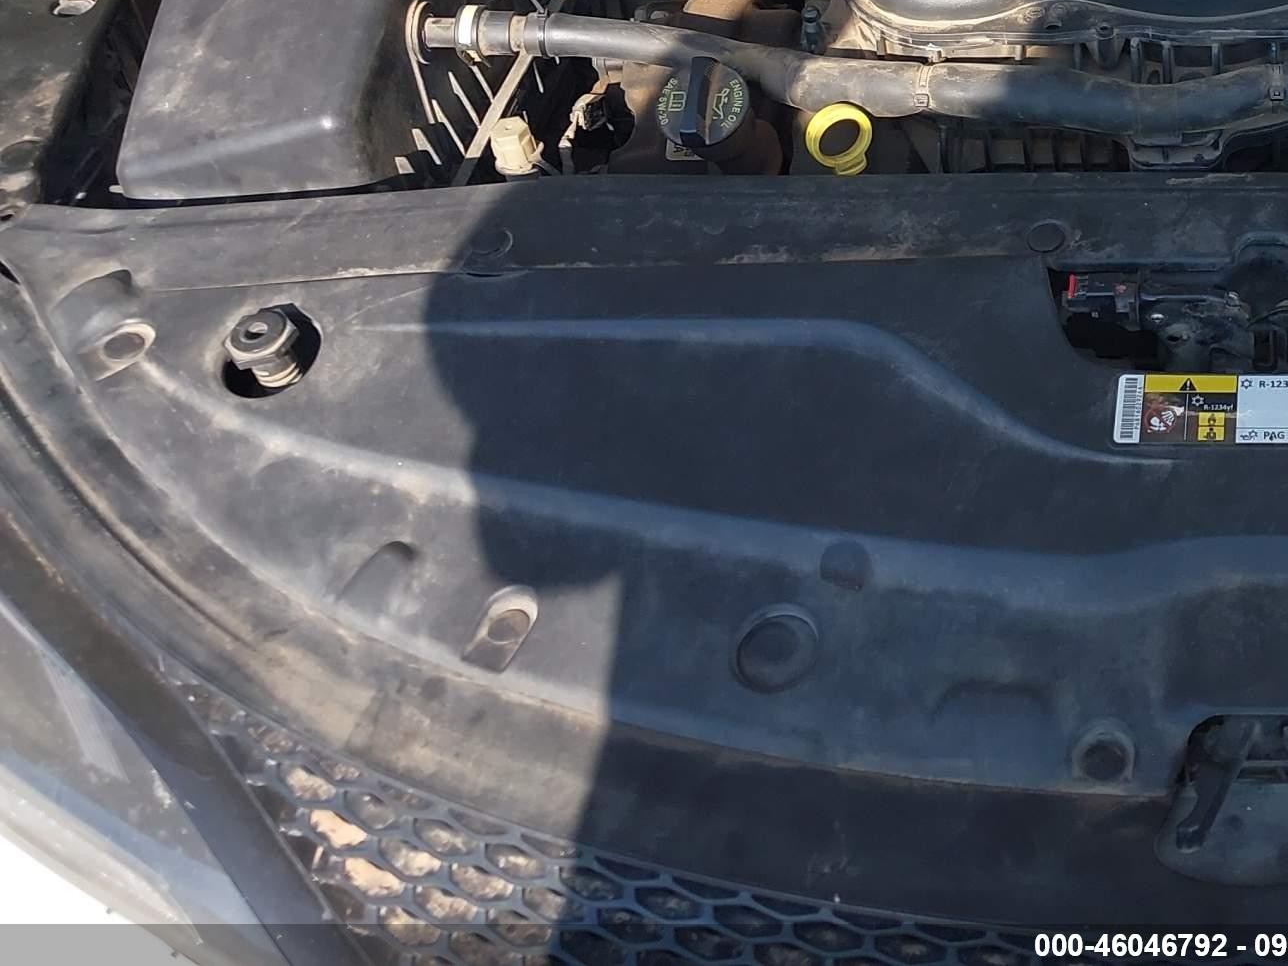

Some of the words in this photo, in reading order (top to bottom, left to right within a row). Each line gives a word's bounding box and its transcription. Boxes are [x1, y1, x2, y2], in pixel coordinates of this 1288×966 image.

[662, 77, 678, 95] SAE
[729, 79, 744, 114] ENGINE
[720, 114, 737, 129] OIL
[1203, 403, 1234, 412] R-1234yf
[1263, 431, 1285, 440] PAG
